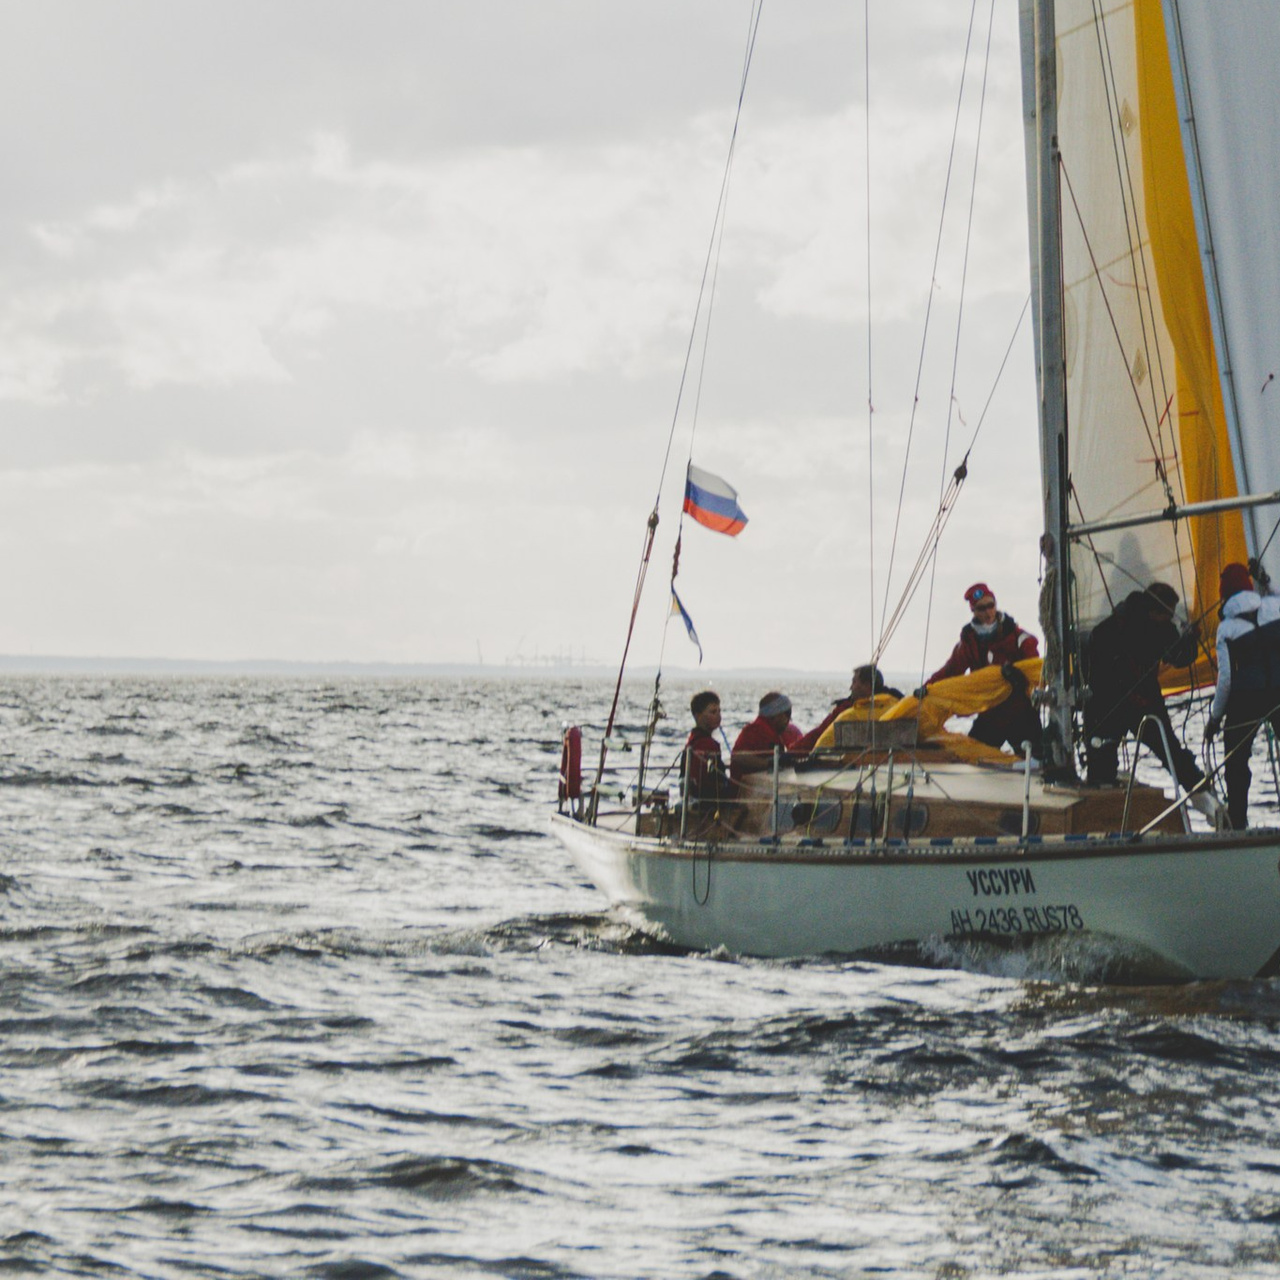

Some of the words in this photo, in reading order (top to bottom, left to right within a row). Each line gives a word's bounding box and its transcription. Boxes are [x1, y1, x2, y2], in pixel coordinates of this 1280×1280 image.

[966, 868, 1036, 896] УССУРИ
[976, 906, 1022, 933] 2436
[1023, 903, 1084, 932] RUS78
